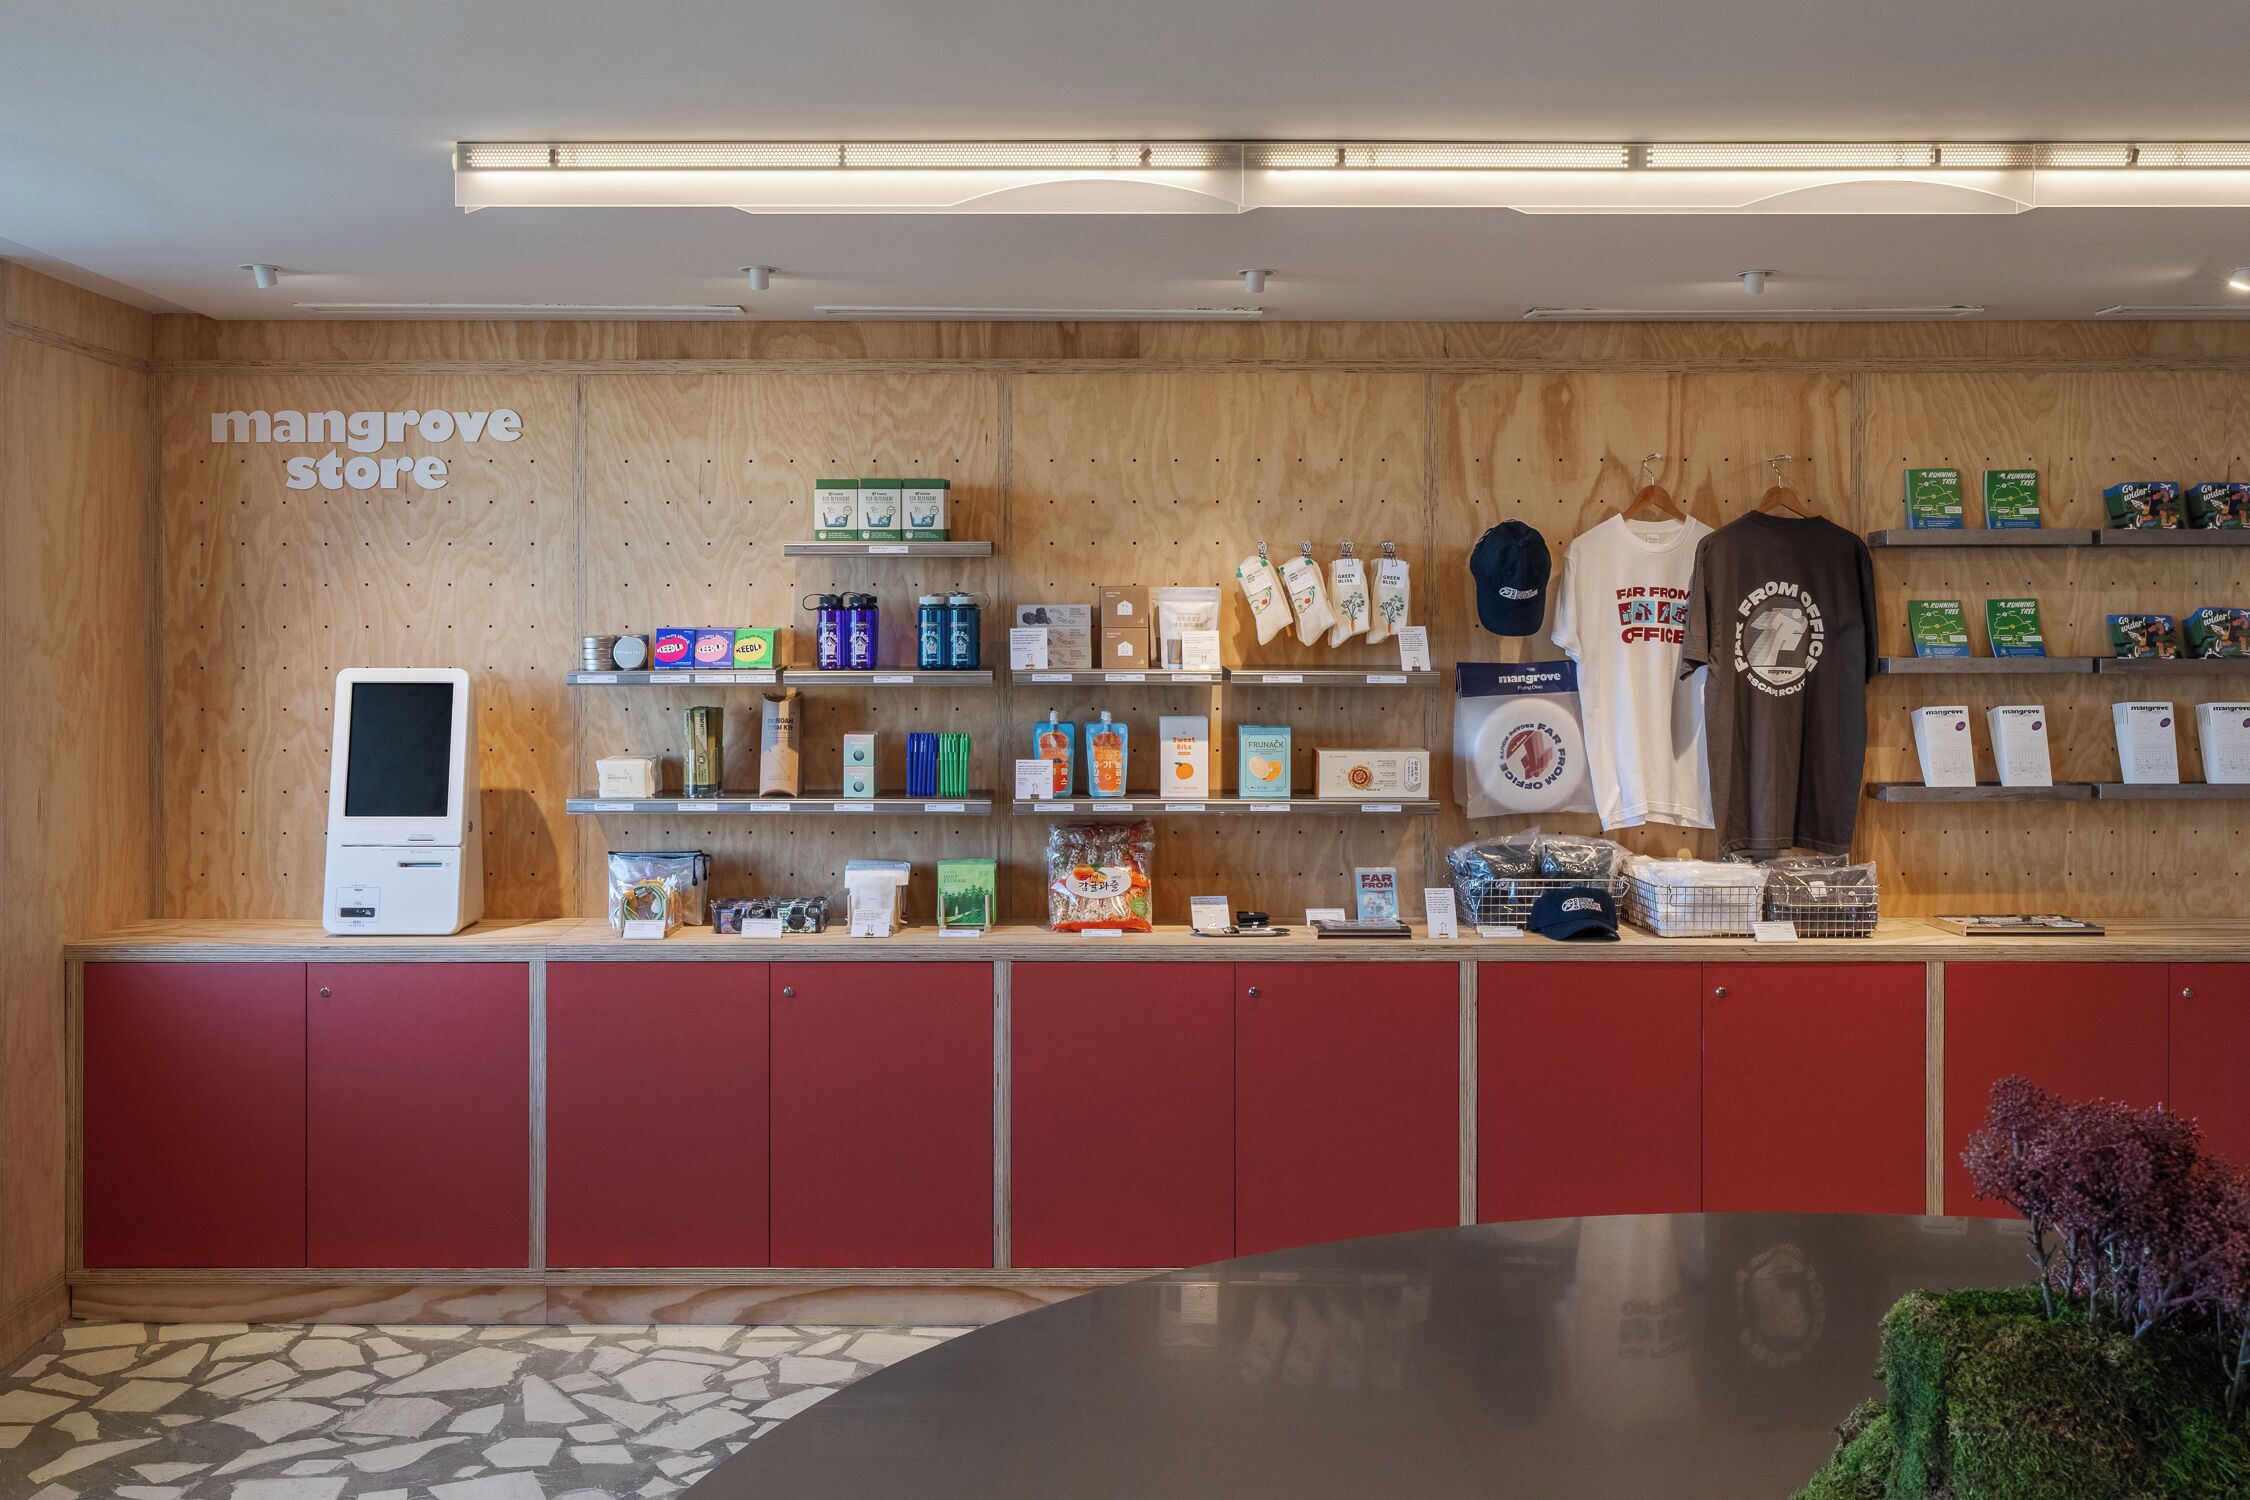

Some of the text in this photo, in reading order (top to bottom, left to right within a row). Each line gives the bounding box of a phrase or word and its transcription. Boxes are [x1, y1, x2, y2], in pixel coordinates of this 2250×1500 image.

[211, 408, 523, 453] mangrove
[286, 448, 449, 490] store
[2122, 484, 2134, 493] Go
[2123, 484, 2151, 502] wider!
[2201, 484, 2213, 493] Go
[2203, 484, 2230, 501] wider!
[1616, 586, 1646, 600] FAR
[2118, 616, 2129, 625] Go
[2201, 609, 2213, 618] Go
[2203, 609, 2231, 626] wider!
[1734, 581, 1825, 673] FAR FROM OFFICE
[2120, 616, 2146, 633] wider!
[1621, 626, 1685, 645] OFFICE
[1498, 673, 1561, 684] mangrove
[2002, 708, 2040, 716] mangrove
[1499, 722, 1566, 790] FAR FROM OFFICE
[1361, 874, 1393, 882] FAR
